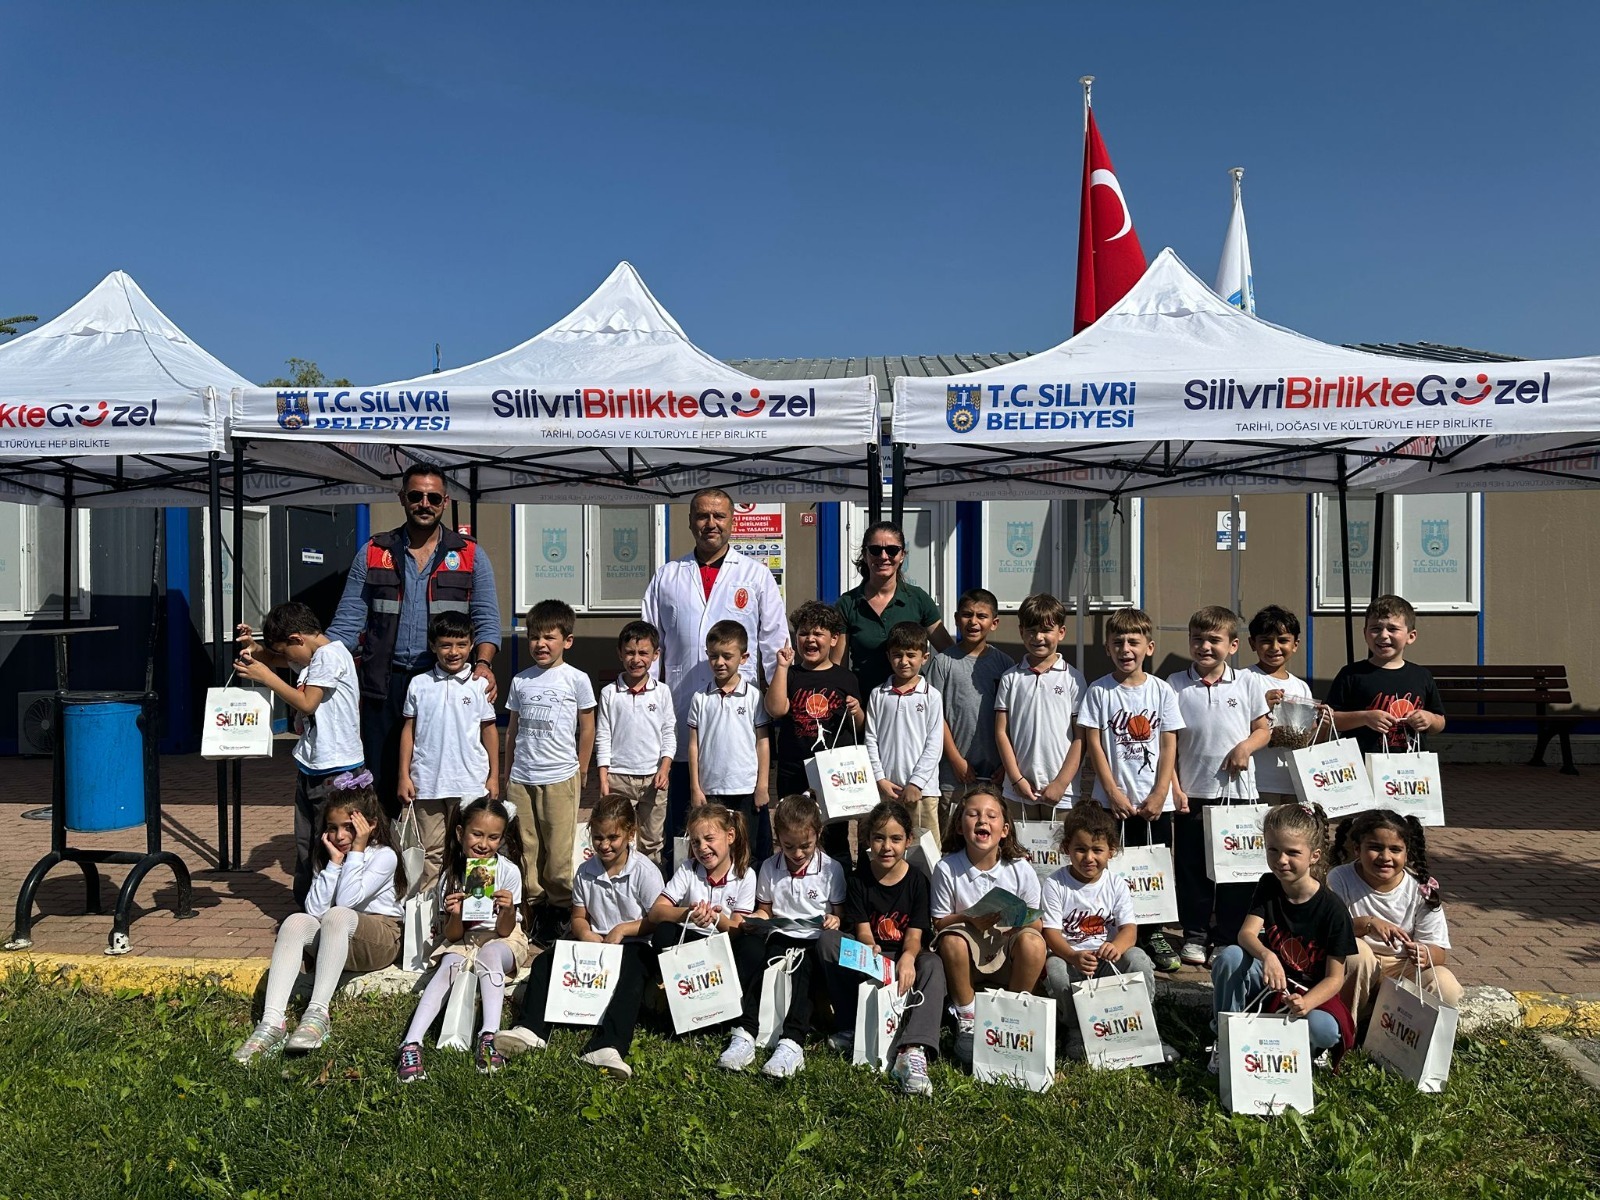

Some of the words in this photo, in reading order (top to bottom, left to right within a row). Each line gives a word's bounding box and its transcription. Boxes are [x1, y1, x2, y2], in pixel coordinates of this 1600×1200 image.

[314, 391, 358, 412] T.C.
[987, 384, 1034, 408] T.C.
[1276, 420, 1320, 432] DOĞASI
[1324, 421, 1338, 430] VE
[1340, 418, 1413, 430] KÜLTÜRÜYLE
[1416, 420, 1440, 429] HEP
[1443, 417, 1492, 428] BİRLİKTE
[577, 428, 616, 439] DOĞASI
[618, 430, 632, 438] VE
[634, 428, 698, 438] KÜLTÜRÜYLE
[702, 430, 722, 438] HEP
[724, 429, 767, 438] BİRLİKTE
[48, 440, 68, 448] HEP
[70, 438, 110, 448] BİRLİKTE
